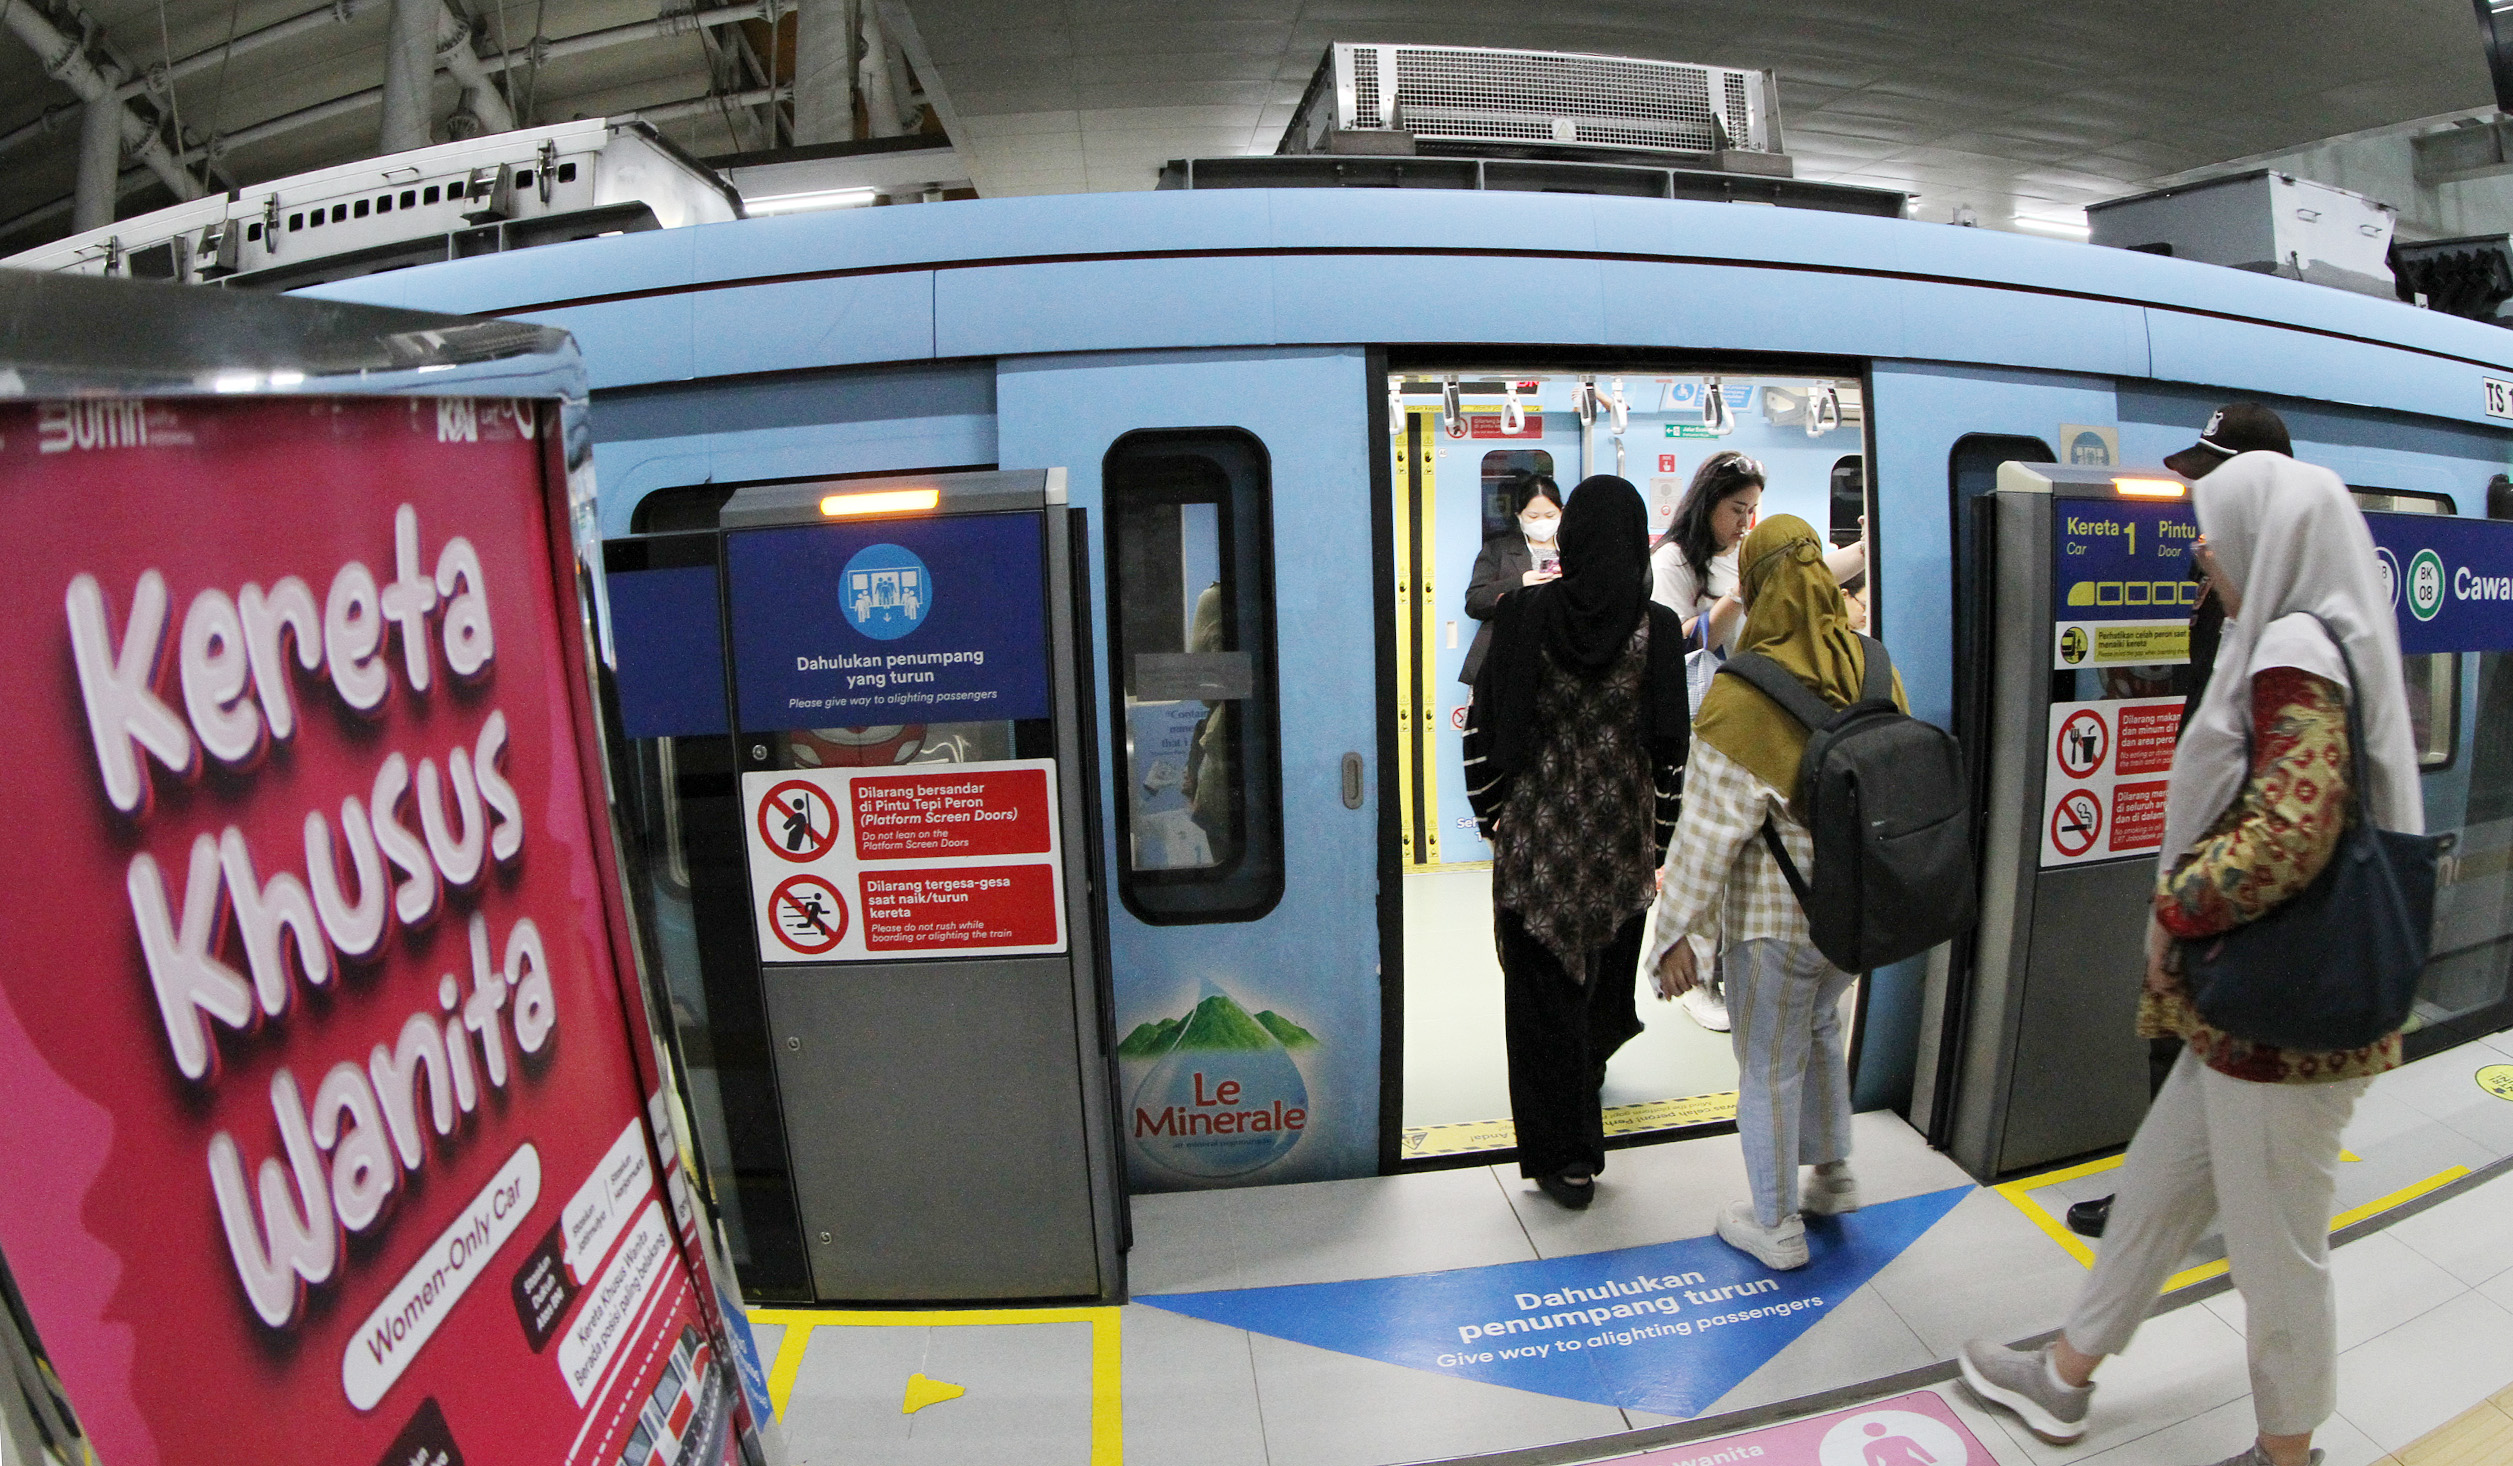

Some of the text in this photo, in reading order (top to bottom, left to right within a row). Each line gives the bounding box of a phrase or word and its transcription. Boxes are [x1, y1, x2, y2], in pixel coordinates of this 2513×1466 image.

[2486, 382, 2504, 413] TS
[2067, 517, 2196, 555] Kereta 1 Pintu
[2066, 541, 2182, 557] Car Door
[2421, 566, 2433, 580] BK
[2419, 585, 2433, 600] 08
[65, 502, 494, 812] Kereta
[797, 650, 984, 672] Dahulukan penumpang
[846, 670, 935, 689] yang turun
[789, 689, 998, 709] Please give way to alighting passengers
[2123, 712, 2182, 725] Dilarang makan
[2121, 726, 2137, 736] dan
[2138, 724, 2164, 735] minum
[2165, 722, 2174, 732] di
[2121, 738, 2136, 747] dan
[858, 783, 985, 800] Dilarang bersandar
[2117, 792, 2150, 801] Dilarang
[859, 796, 983, 811] di Pintu Tepi Peron
[2116, 802, 2124, 813] di
[2126, 800, 2154, 812] seluruh
[860, 807, 1018, 828] (Platform Screen Doors)
[2115, 814, 2130, 823] dan
[2132, 811, 2140, 822] di
[862, 829, 949, 841] Do not lean on the
[863, 837, 969, 851] Platform Screen Doors
[867, 876, 1011, 894] Dilarang tergesa-gesa
[127, 709, 523, 1079] Khusus
[868, 890, 969, 905] saat naik/turun
[869, 906, 912, 919] kereta
[871, 920, 985, 933] Please do not rush while
[872, 932, 914, 943] boarding
[928, 930, 971, 942] alighting
[973, 930, 987, 939] the
[989, 928, 1013, 938] train
[1193, 1072, 1241, 1108] Le
[207, 909, 556, 1329] Wanita
[1134, 1100, 1306, 1138] Minerale
[1679, 1107, 1712, 1117] celah
[1603, 1117, 1634, 1127] Perh
[1470, 1132, 1508, 1142] Anda!
[367, 1219, 492, 1367] Women-Only
[492, 1176, 523, 1232] Car
[577, 1231, 648, 1345] Kereta Khusus Wanita
[1513, 1269, 1706, 1312] Dahulukan
[574, 1232, 667, 1387] Berada posisi paling belakang
[1457, 1274, 1780, 1344] penumpang turun
[1436, 1293, 1824, 1369] Give way to alighting passengers
